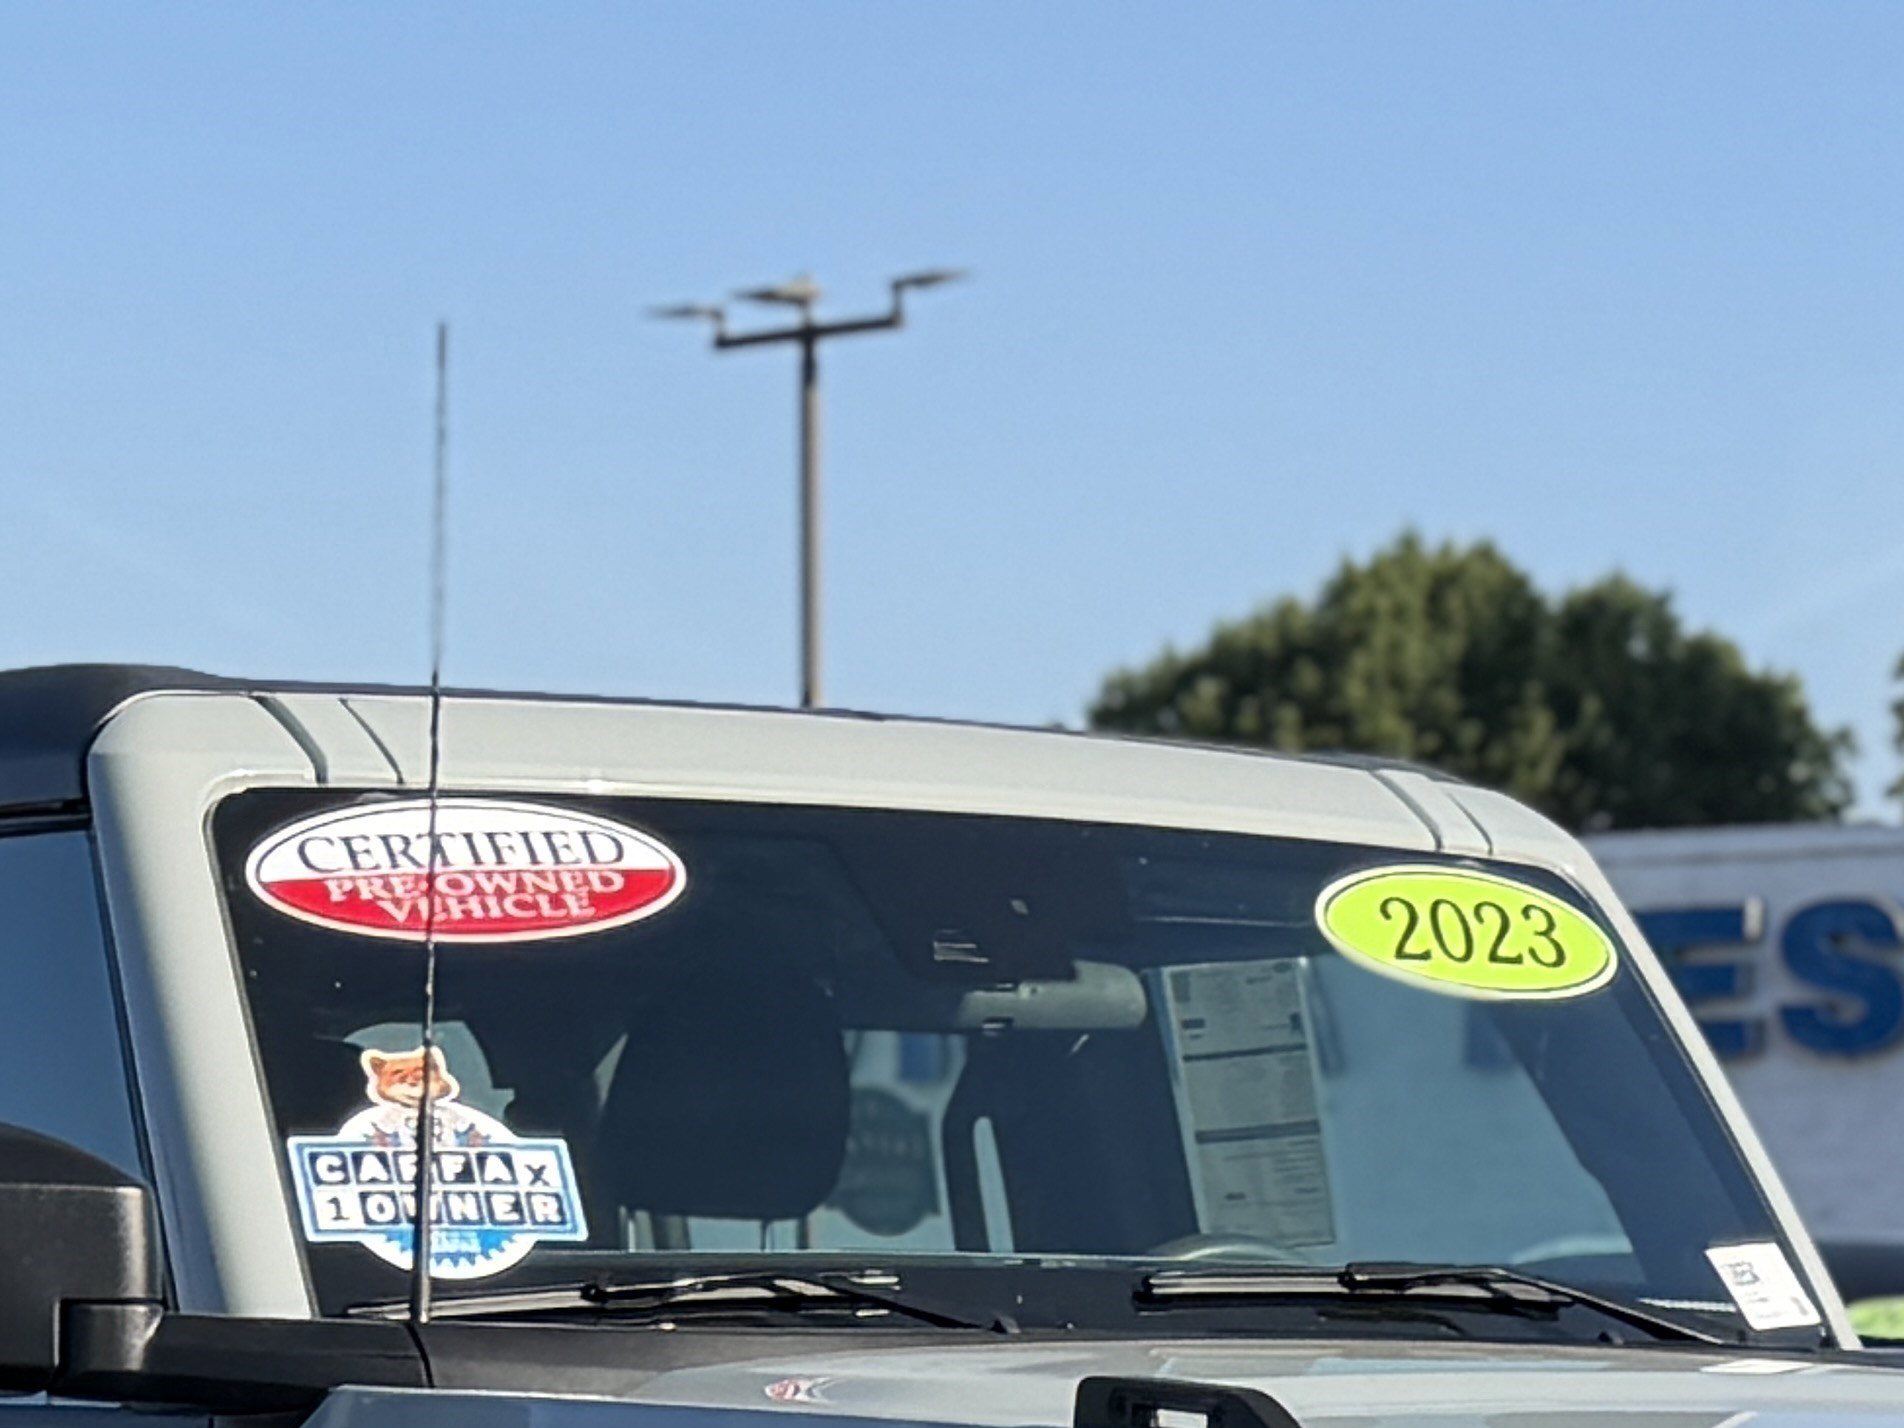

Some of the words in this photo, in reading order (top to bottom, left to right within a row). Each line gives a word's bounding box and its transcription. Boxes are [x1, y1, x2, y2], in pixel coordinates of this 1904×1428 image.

[297, 830, 625, 873] CERTIFIED
[377, 890, 597, 924] VEHICLE
[1380, 896, 1567, 969] 2023
[324, 1195, 350, 1222] 1
[363, 1190, 563, 1225] OWNER
